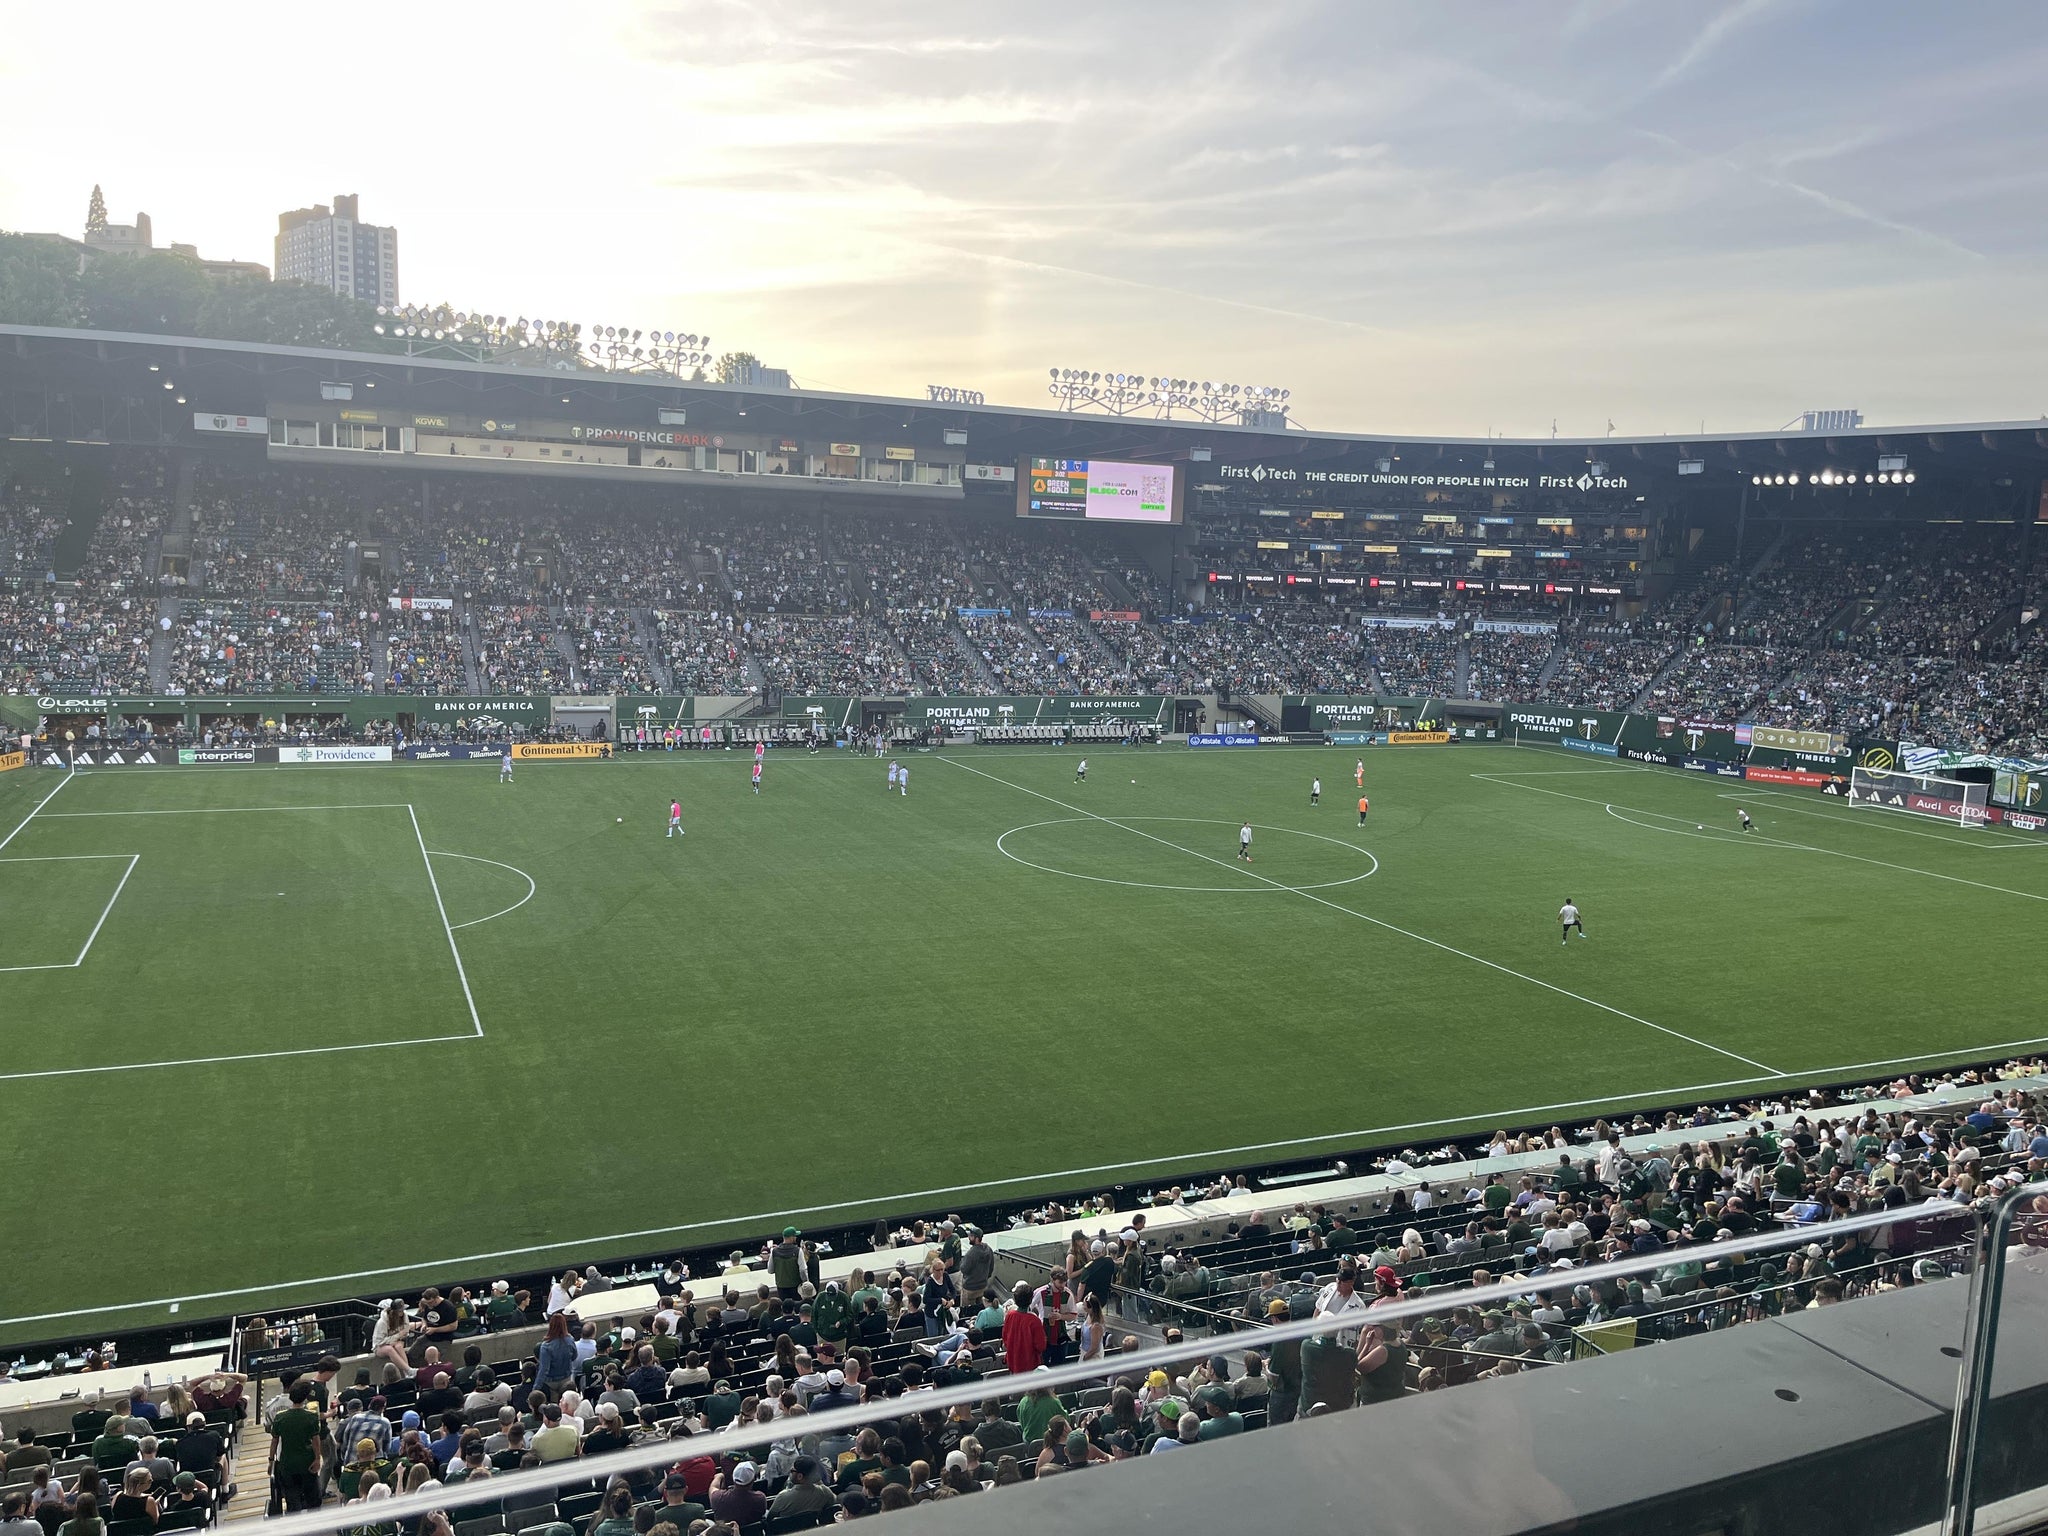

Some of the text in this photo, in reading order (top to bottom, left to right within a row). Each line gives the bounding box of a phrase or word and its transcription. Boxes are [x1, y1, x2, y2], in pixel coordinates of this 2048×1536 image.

[928, 385, 984, 405] VOLVO
[1220, 465, 1296, 481] First Tech
[1305, 472, 1529, 487] THE CREDIT UNION FOR PEOPLE IN TECH
[1539, 476, 1627, 489] First Tech
[434, 702, 534, 711] BANK OF AMERICA
[1315, 705, 1375, 715] PORTLAND
[926, 707, 990, 718] PORTLAND
[1510, 713, 1573, 728] PORTLAND
[1523, 724, 1560, 733] TIMBERS
[1393, 734, 1427, 743] Continental
[184, 751, 253, 762] enterprise
[316, 749, 376, 761] Providence
[415, 750, 451, 760] Tillamook
[468, 749, 503, 759] Tillamook
[520, 745, 575, 757] Continental
[1628, 750, 1667, 763] First Tech
[5, 755, 20, 766] Tire
[1795, 752, 1837, 764] TIMBERS
[1916, 799, 1942, 811] Audi
[2015, 821, 2033, 829] TIRE
